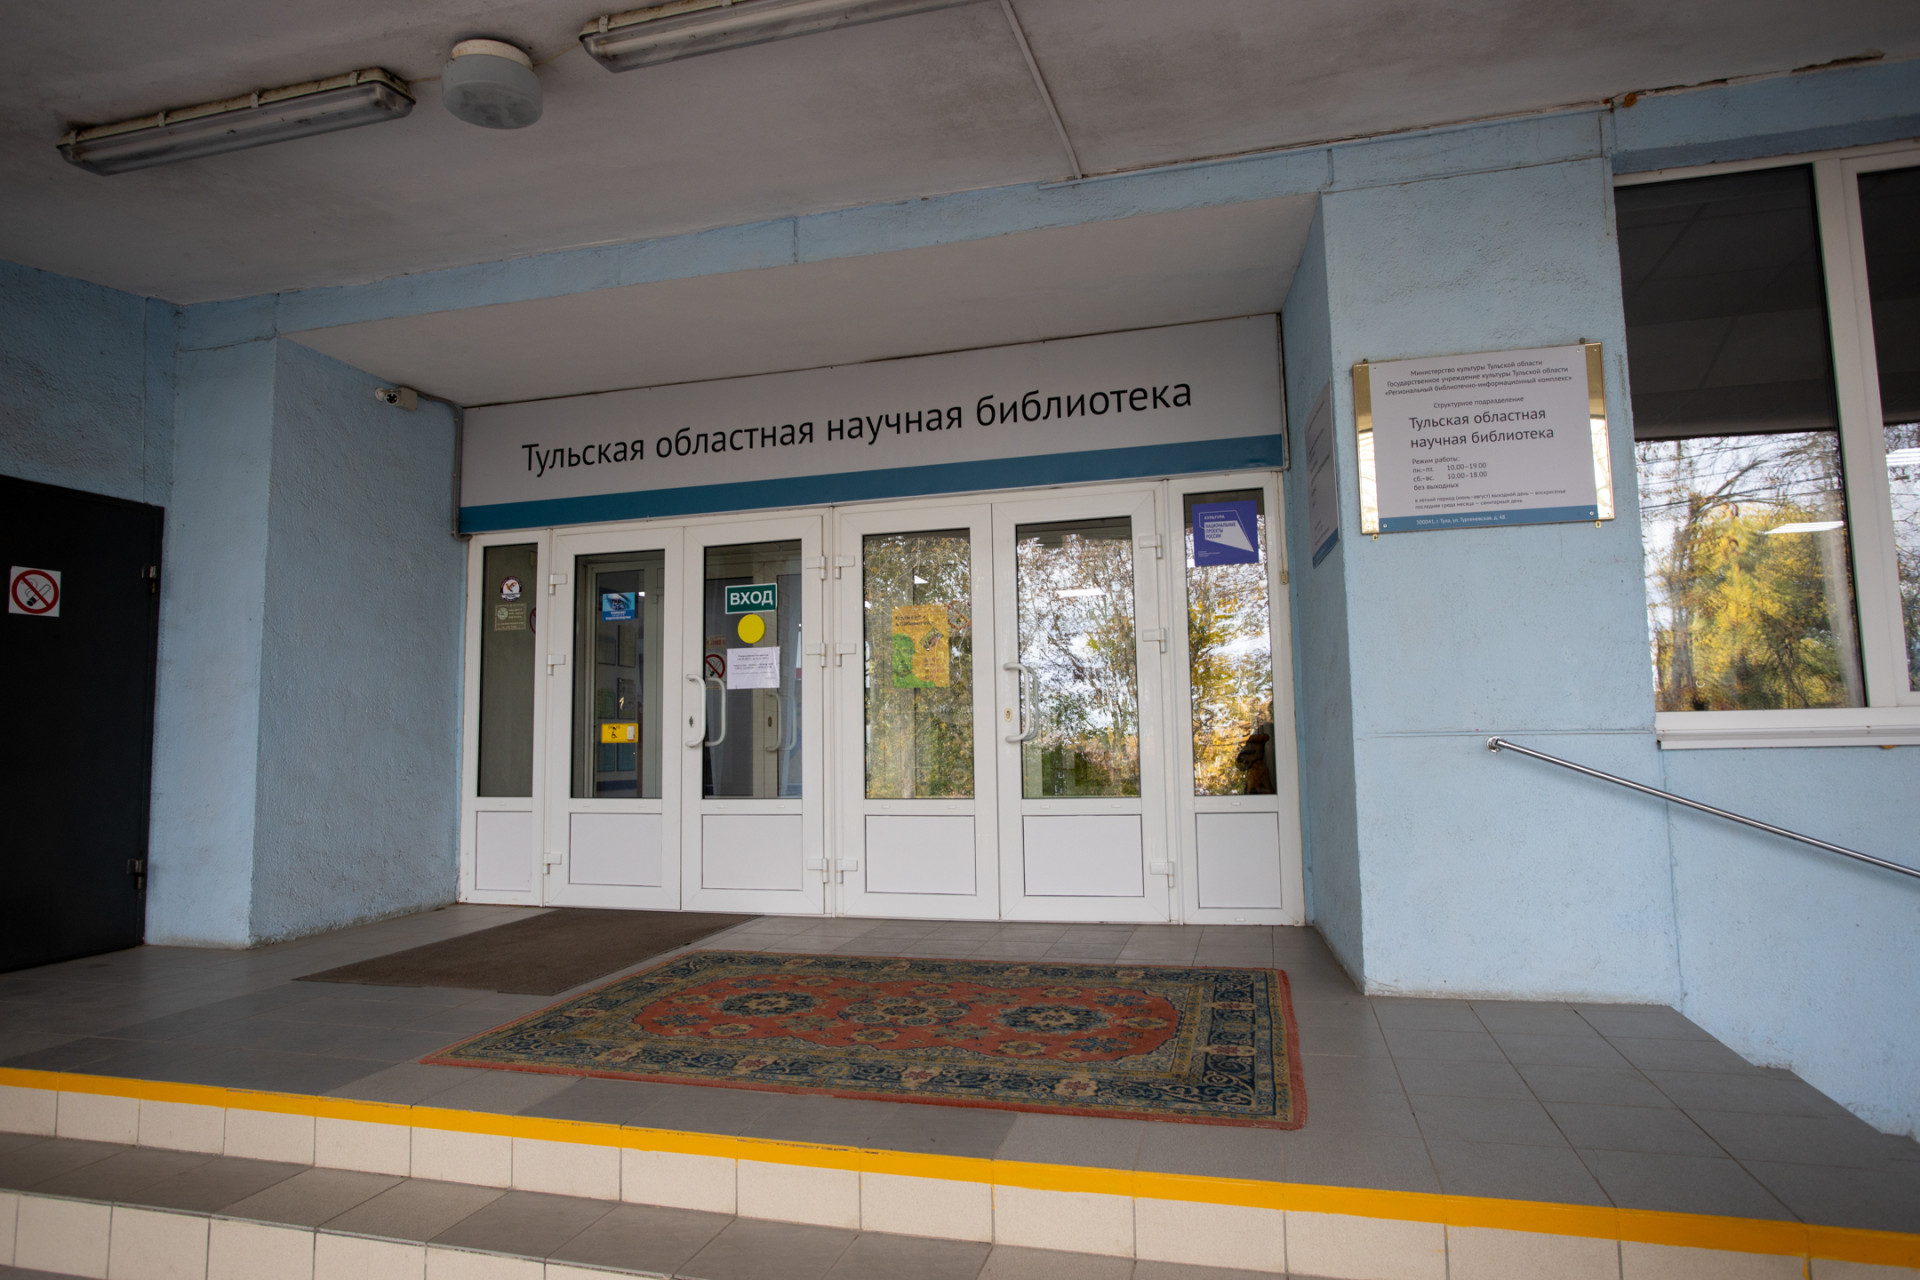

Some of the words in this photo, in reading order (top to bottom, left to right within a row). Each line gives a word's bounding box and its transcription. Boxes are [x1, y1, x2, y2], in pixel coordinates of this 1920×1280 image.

[1387, 378, 1439, 388] Государственное
[1441, 374, 1480, 383] учреждение
[1482, 371, 1511, 380] культуры
[1512, 368, 1541, 377] Тульской
[1542, 366, 1568, 374] области
[1410, 367, 1455, 376] Министерство
[1457, 365, 1485, 373] культуры
[1487, 362, 1515, 370] Тульской
[1385, 385, 1434, 396] «Региональный
[1433, 400, 1473, 409] Структурное
[1474, 396, 1524, 405] подразделение
[1408, 415, 1469, 431] Тульская
[1473, 409, 1546, 424] областная
[521, 439, 644, 478] Тульская
[656, 420, 814, 458] областная
[827, 405, 963, 445] научная
[976, 382, 1192, 427] библиотека
[1410, 434, 1467, 450] научная
[1471, 428, 1554, 444] библиотека
[1434, 456, 1460, 464] работы:
[730, 590, 773, 606] ВХОД
